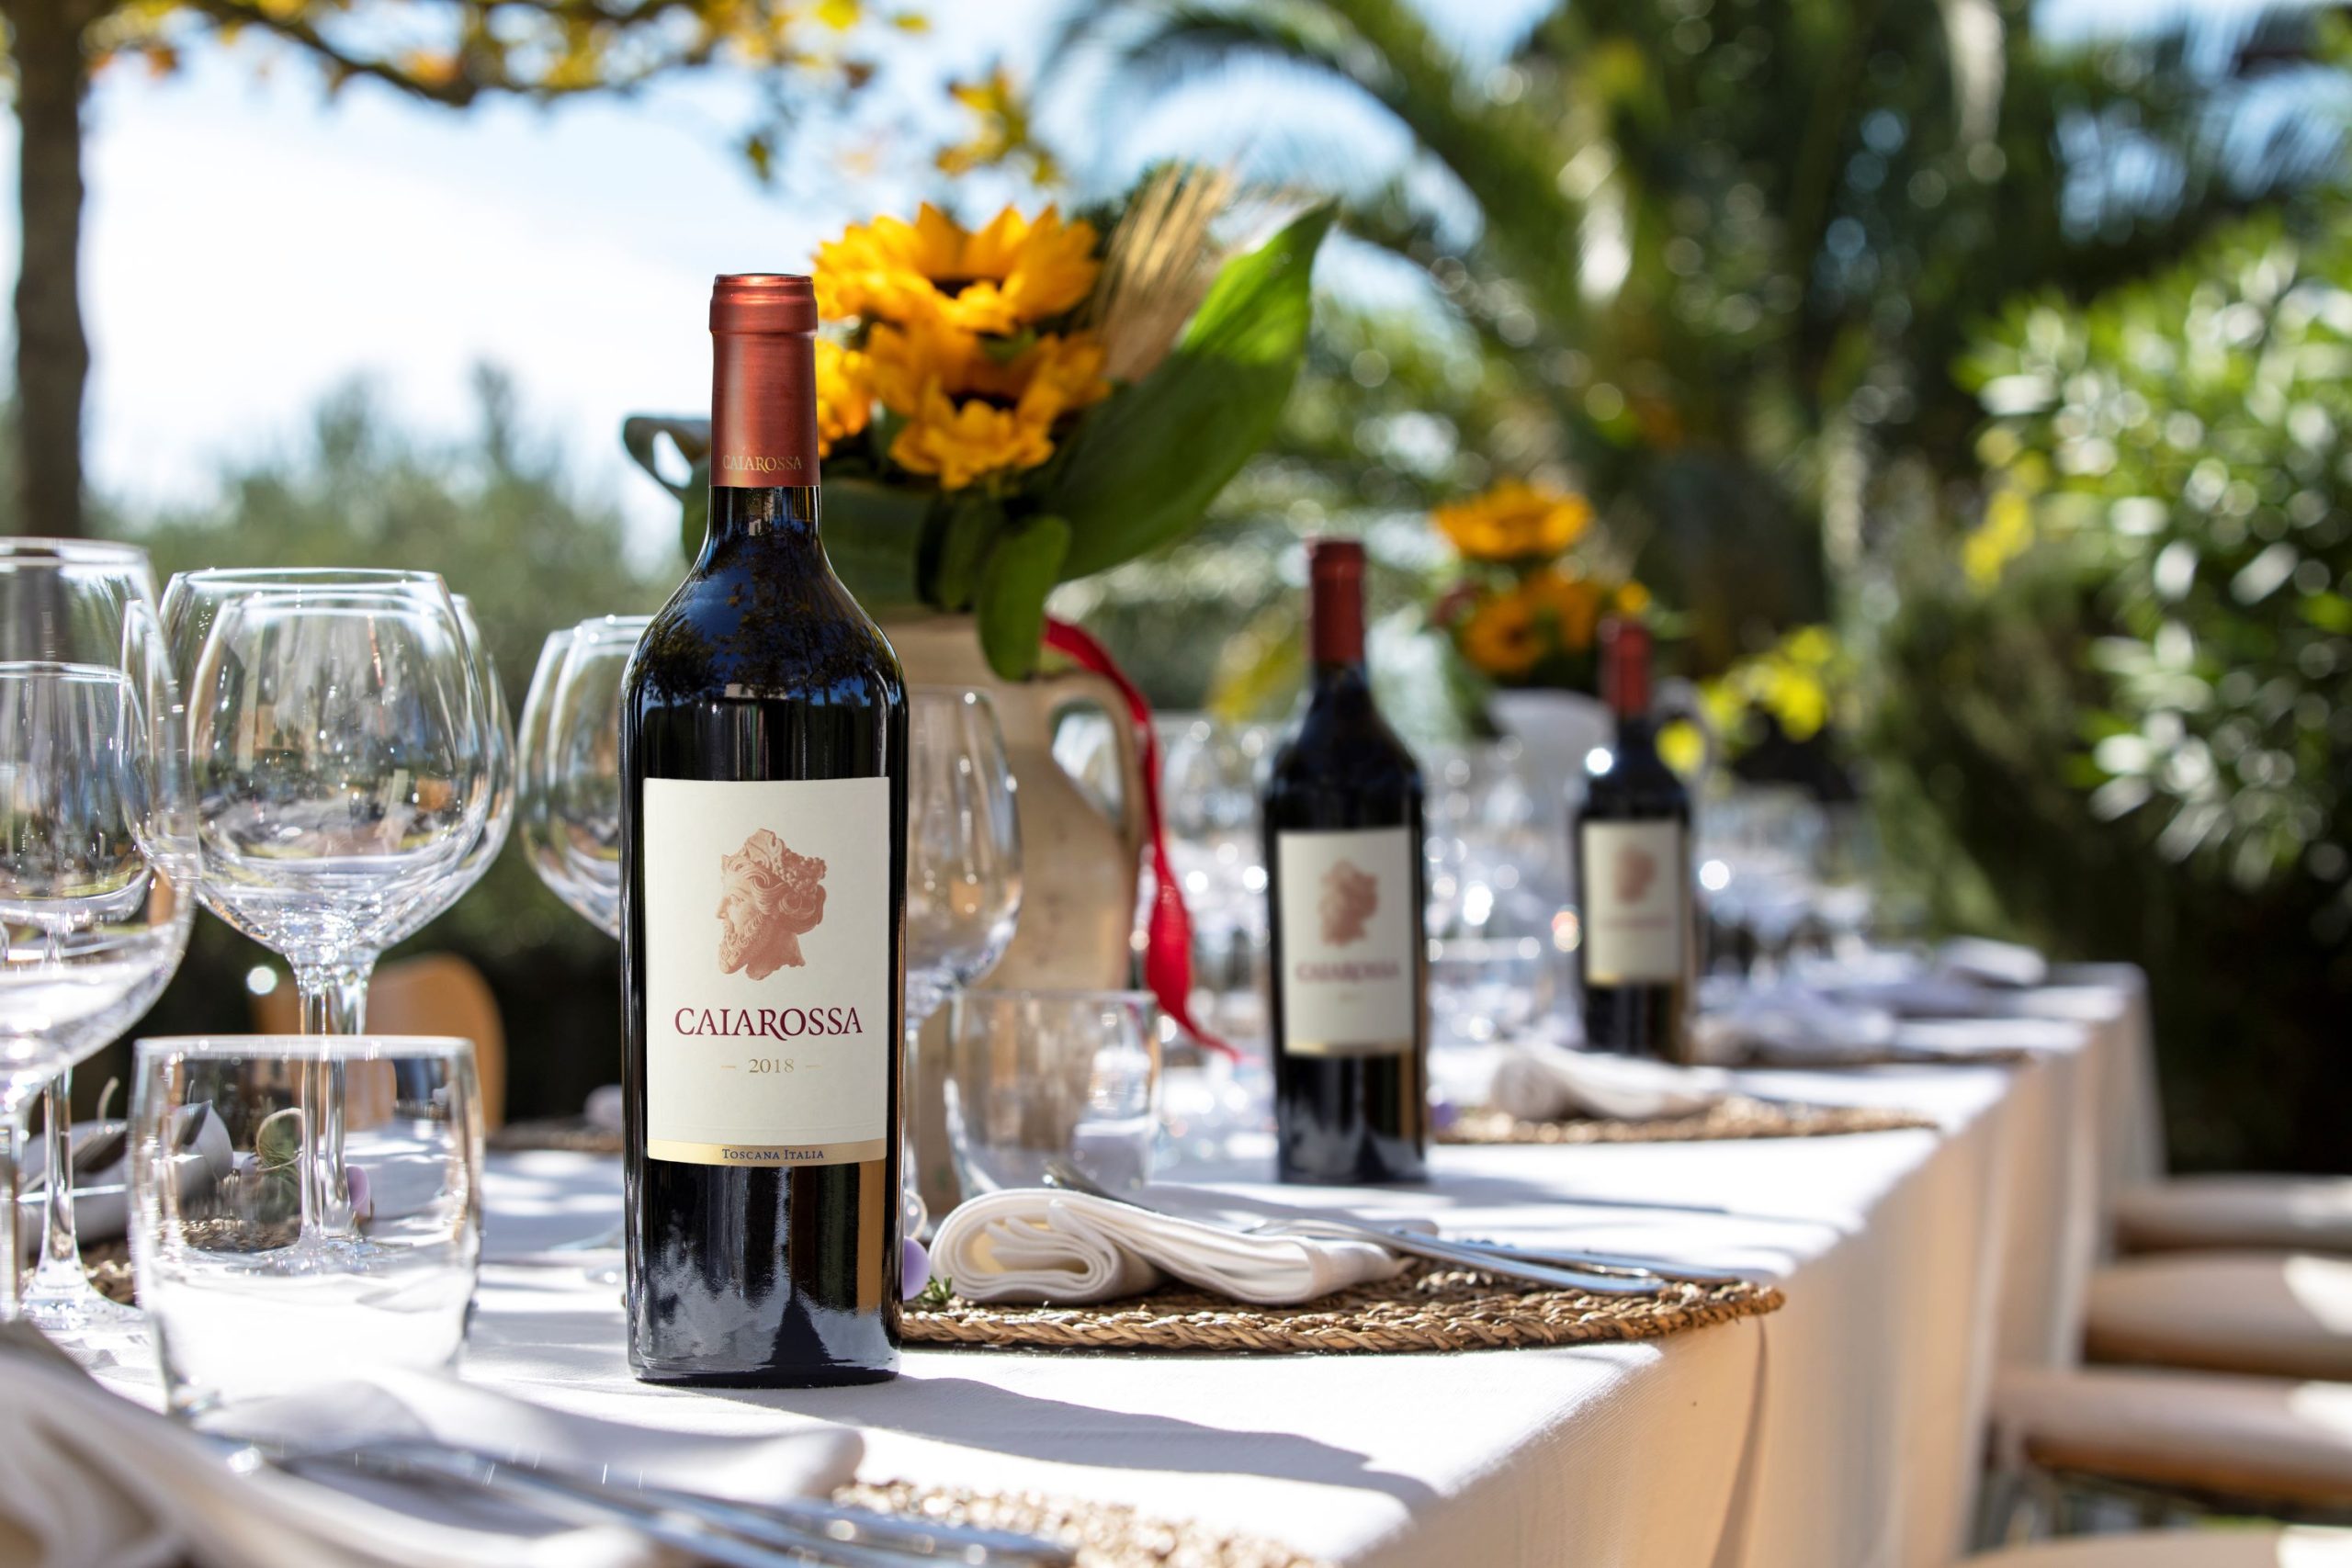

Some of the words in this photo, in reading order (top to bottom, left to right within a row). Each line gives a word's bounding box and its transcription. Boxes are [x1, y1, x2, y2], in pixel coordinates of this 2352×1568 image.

[722, 455, 802, 473] CAIAROSSA
[675, 1007, 863, 1041] CAIAROSSA
[749, 1058, 795, 1073] 2018
[721, 1148, 780, 1160] TOSCANA
[784, 1148, 824, 1160] ITALIA
